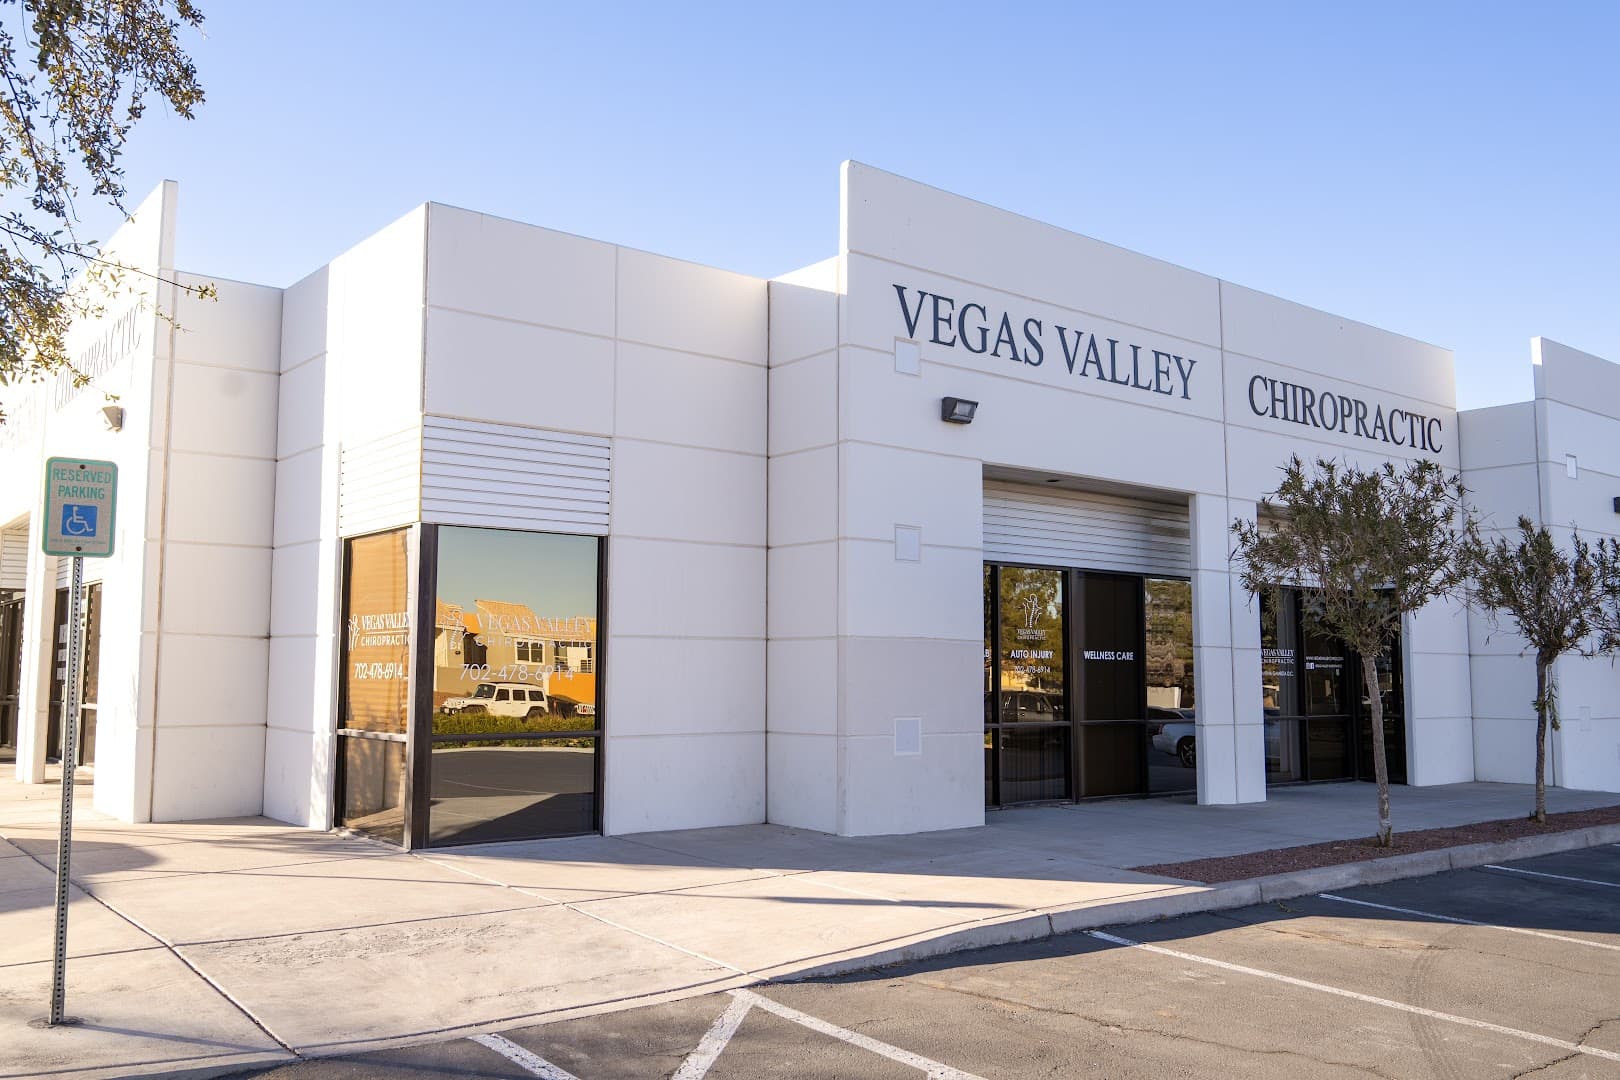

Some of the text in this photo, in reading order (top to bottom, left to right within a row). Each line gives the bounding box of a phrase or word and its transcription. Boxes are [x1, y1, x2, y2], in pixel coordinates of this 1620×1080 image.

[892, 284, 1197, 400] VEGAS VALLEY
[1249, 375, 1443, 454] CHIROPRACTIC
[53, 468, 112, 484] RESERVED
[58, 485, 105, 500] PARKING
[361, 614, 385, 630] VEGAS
[477, 613, 592, 633] VEGAS VALLEY
[474, 635, 593, 650] CHIROPRACTIC
[1010, 649, 1054, 659] AUTO INJURY
[1083, 650, 1134, 661] WELLNESS CARE
[354, 662, 403, 679] 702-478-6914
[459, 663, 574, 681] 702-478-6914
